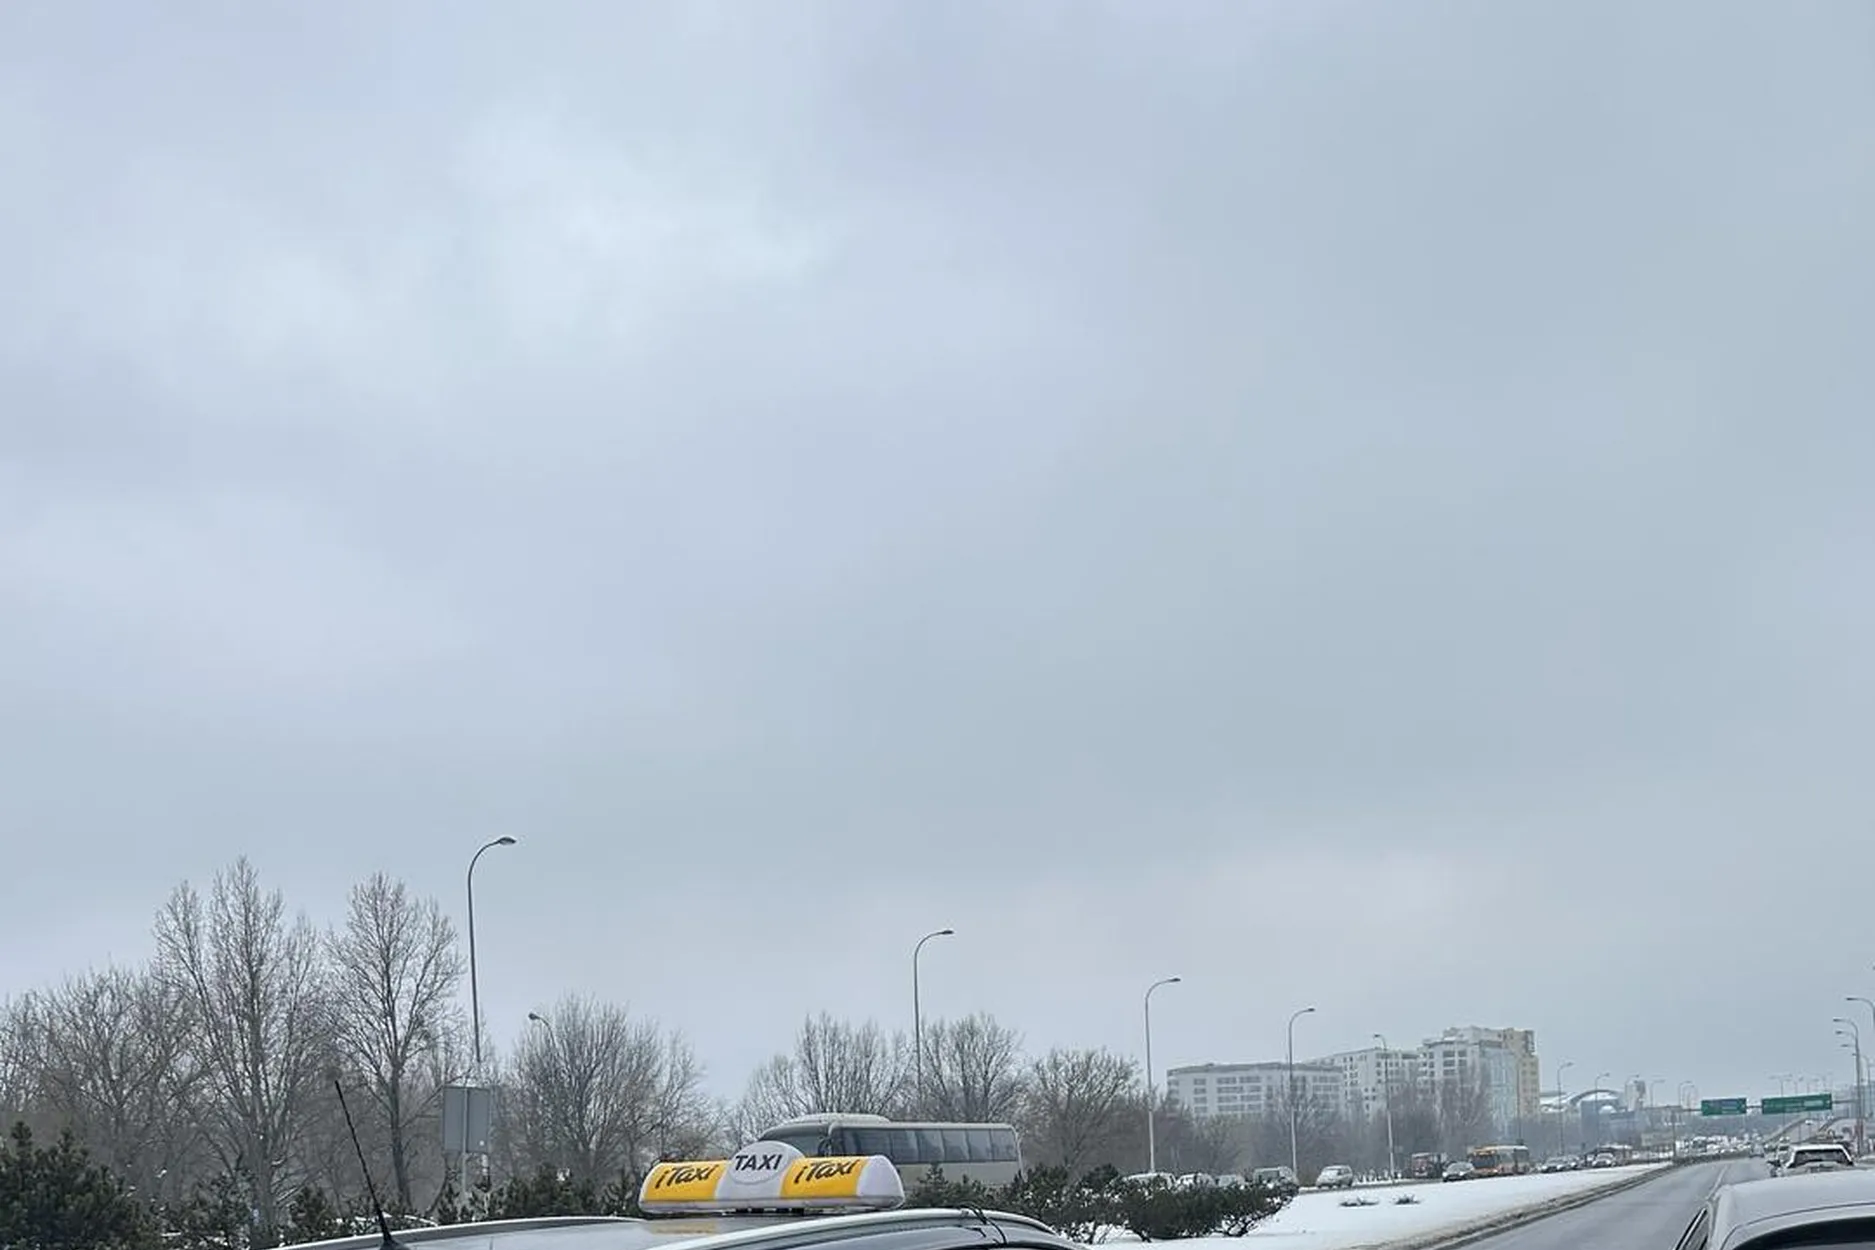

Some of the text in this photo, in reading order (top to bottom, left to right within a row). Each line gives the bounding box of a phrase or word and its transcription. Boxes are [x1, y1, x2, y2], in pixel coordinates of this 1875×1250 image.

[735, 1153, 783, 1171] TAXI
[794, 1159, 857, 1185] iTaxi
[655, 1164, 717, 1189] iTaxi
